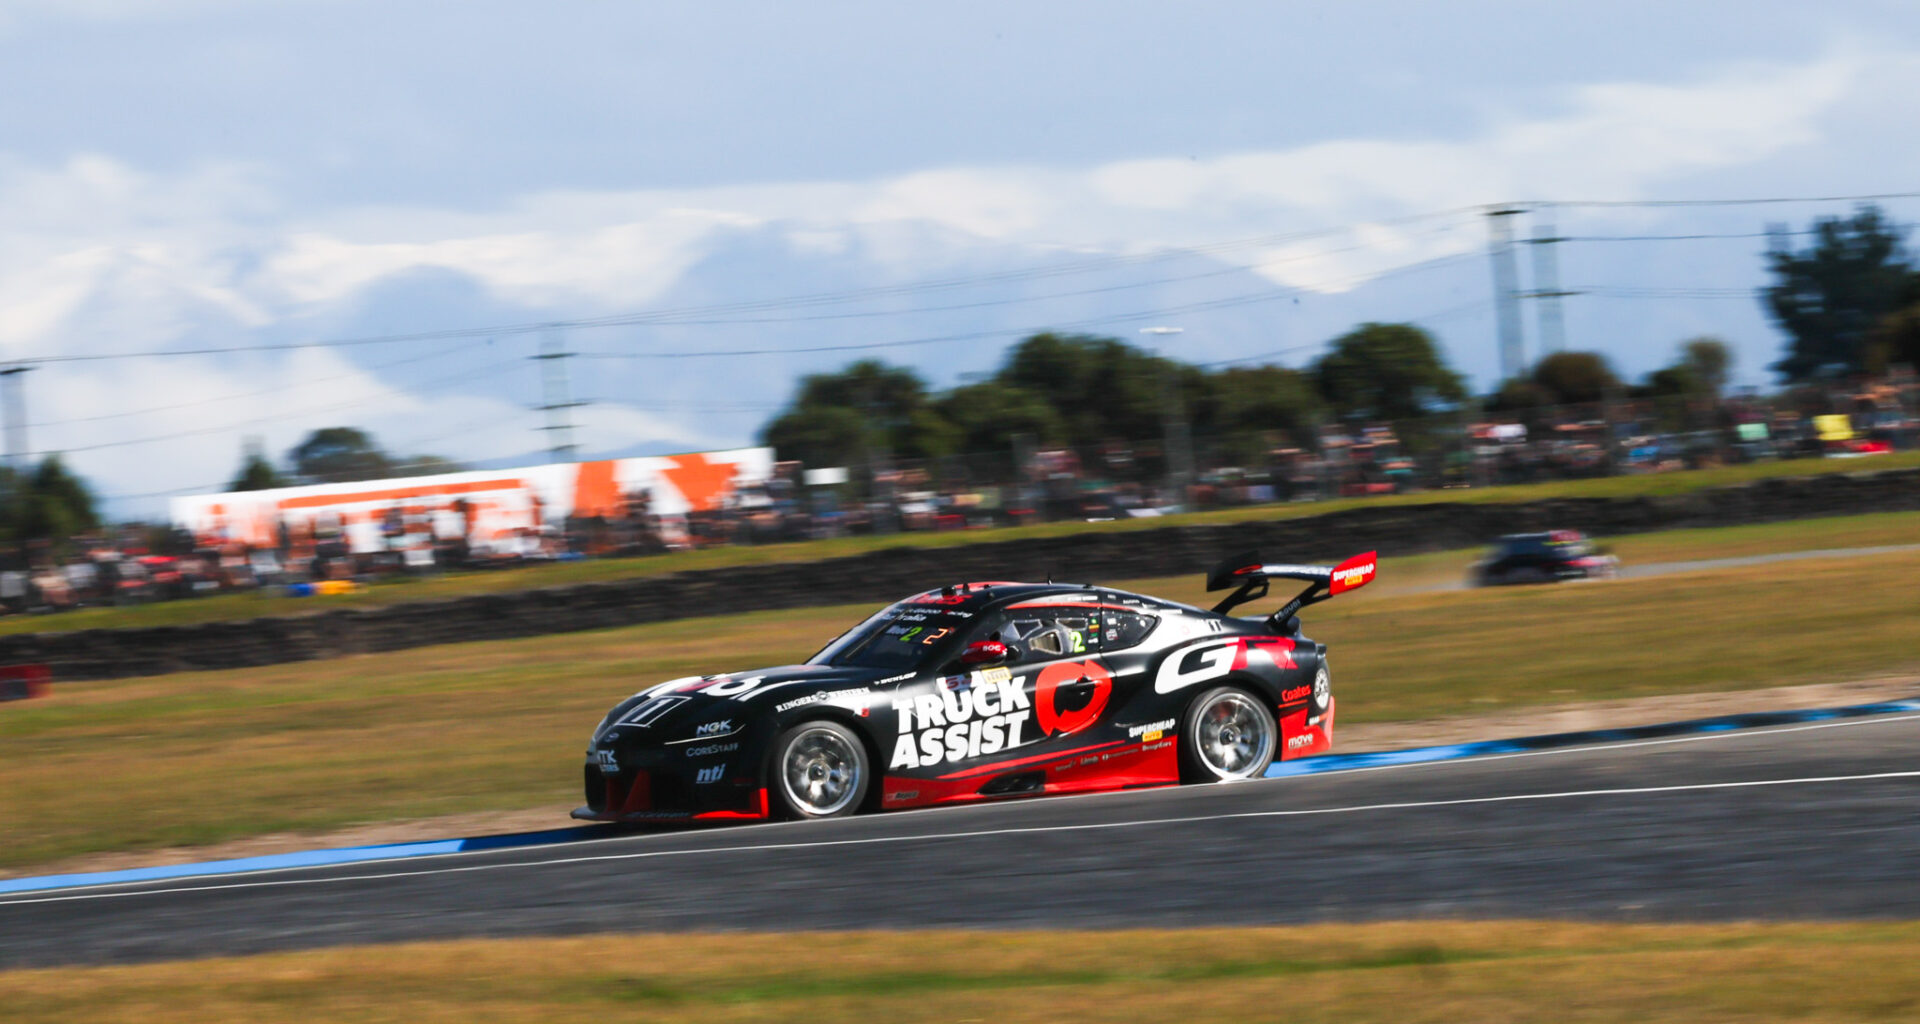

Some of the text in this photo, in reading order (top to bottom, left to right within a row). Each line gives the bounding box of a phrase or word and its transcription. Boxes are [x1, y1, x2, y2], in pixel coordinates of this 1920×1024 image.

[1333, 563, 1374, 581] SUPERCHEAP
[1070, 631, 1086, 653] 2
[880, 672, 917, 685] DUNLOP
[775, 687, 871, 713] RINGERS WESTERN
[1282, 684, 1312, 702] Coates
[892, 676, 1031, 733] TRUCK
[697, 719, 733, 735] NGK
[1129, 718, 1176, 738] SUPERCHEAP
[889, 710, 1030, 770] ASSIST
[1288, 734, 1313, 750] move
[696, 763, 727, 784] nti
